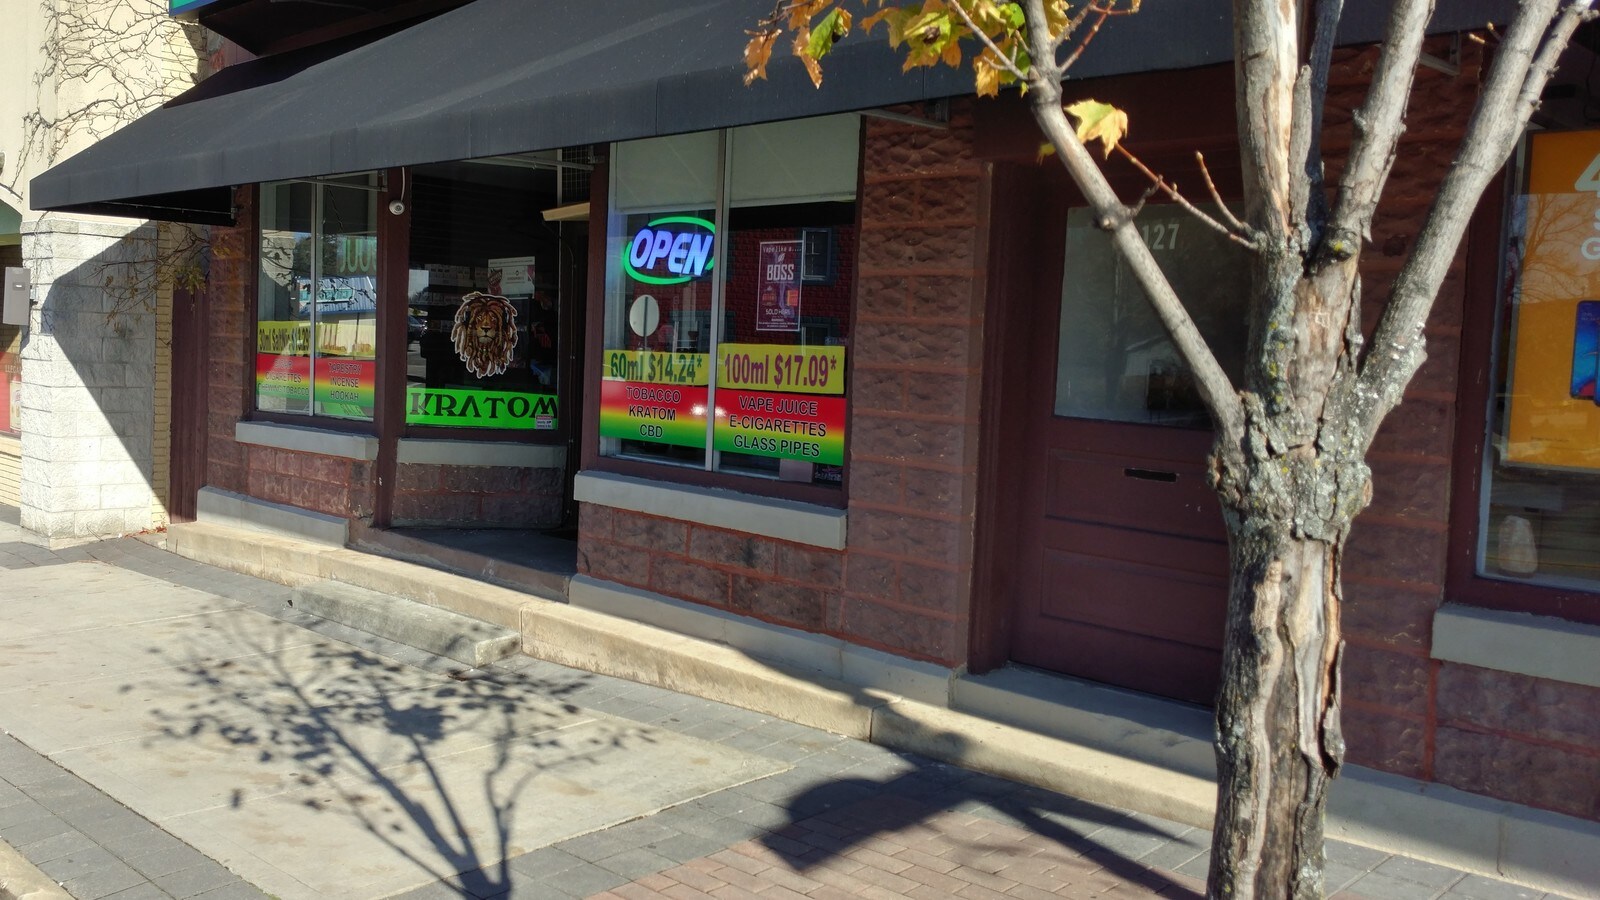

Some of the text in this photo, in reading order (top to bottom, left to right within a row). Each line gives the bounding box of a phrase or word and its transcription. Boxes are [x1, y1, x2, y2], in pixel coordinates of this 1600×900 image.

[1142, 223, 1180, 250] 127
[629, 228, 713, 277] OPEN
[766, 264, 795, 281] BOSS
[328, 362, 362, 375] TAPESTRY
[610, 352, 643, 380] 60ml
[724, 353, 769, 385] 100ml
[265, 371, 302, 383] CIGARETTES
[330, 376, 359, 388] INCENSE
[283, 385, 309, 396] TOBACCO
[330, 390, 359, 401] HOOKAH
[625, 386, 681, 403] TOBACCO
[409, 392, 557, 419] KRATOM
[629, 405, 676, 421] KRATOM
[739, 395, 818, 416] VAPE JUICE
[640, 424, 663, 439] CBD
[729, 414, 827, 438] E-CIGARETTES
[734, 434, 820, 457] GLASS PIPES
